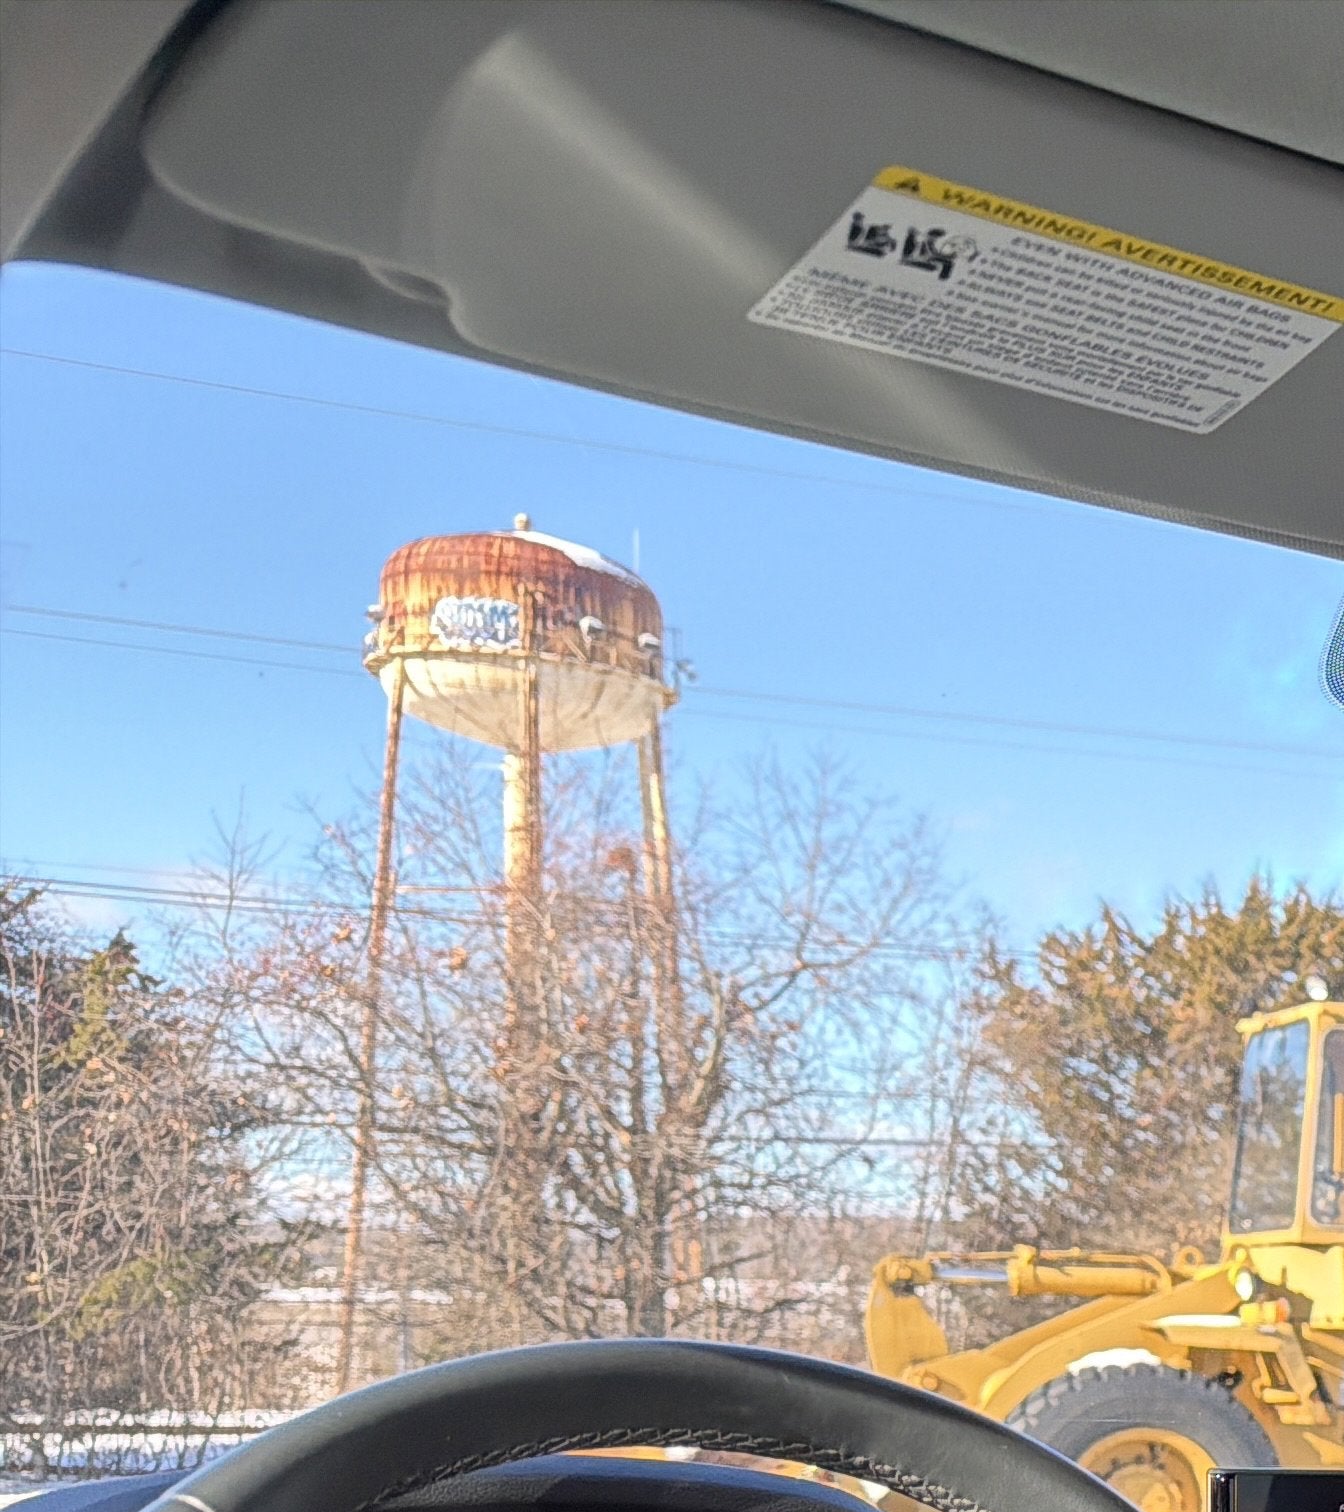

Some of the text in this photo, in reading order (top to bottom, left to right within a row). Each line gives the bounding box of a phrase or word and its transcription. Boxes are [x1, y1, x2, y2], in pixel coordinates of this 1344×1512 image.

[935, 187, 1337, 314] WARNING! AVERTISSEMENT!
[1008, 235, 1294, 324] EVEN WITH ADVANCED AIR BAGS
